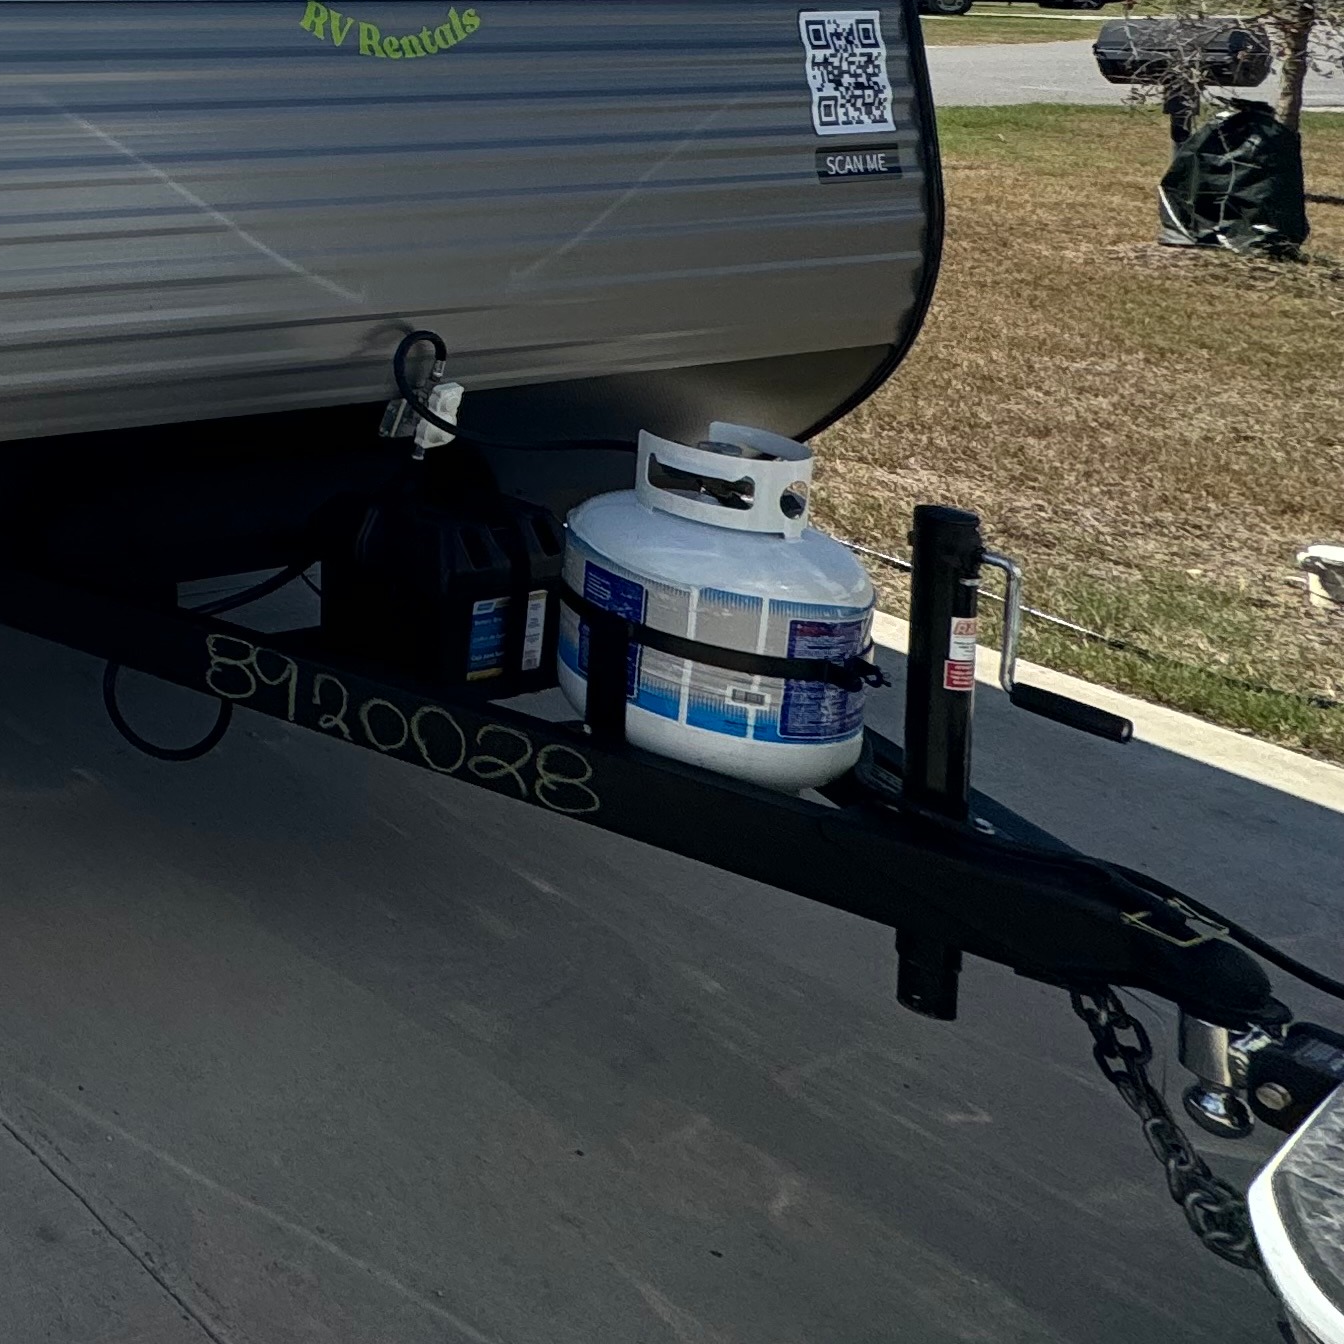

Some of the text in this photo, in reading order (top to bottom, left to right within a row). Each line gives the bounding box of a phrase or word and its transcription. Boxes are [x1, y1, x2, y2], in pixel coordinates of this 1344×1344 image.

[298, 0, 481, 59] RV Rentals
[826, 153, 888, 174] SCAN ME
[204, 632, 601, 815] 8920028
